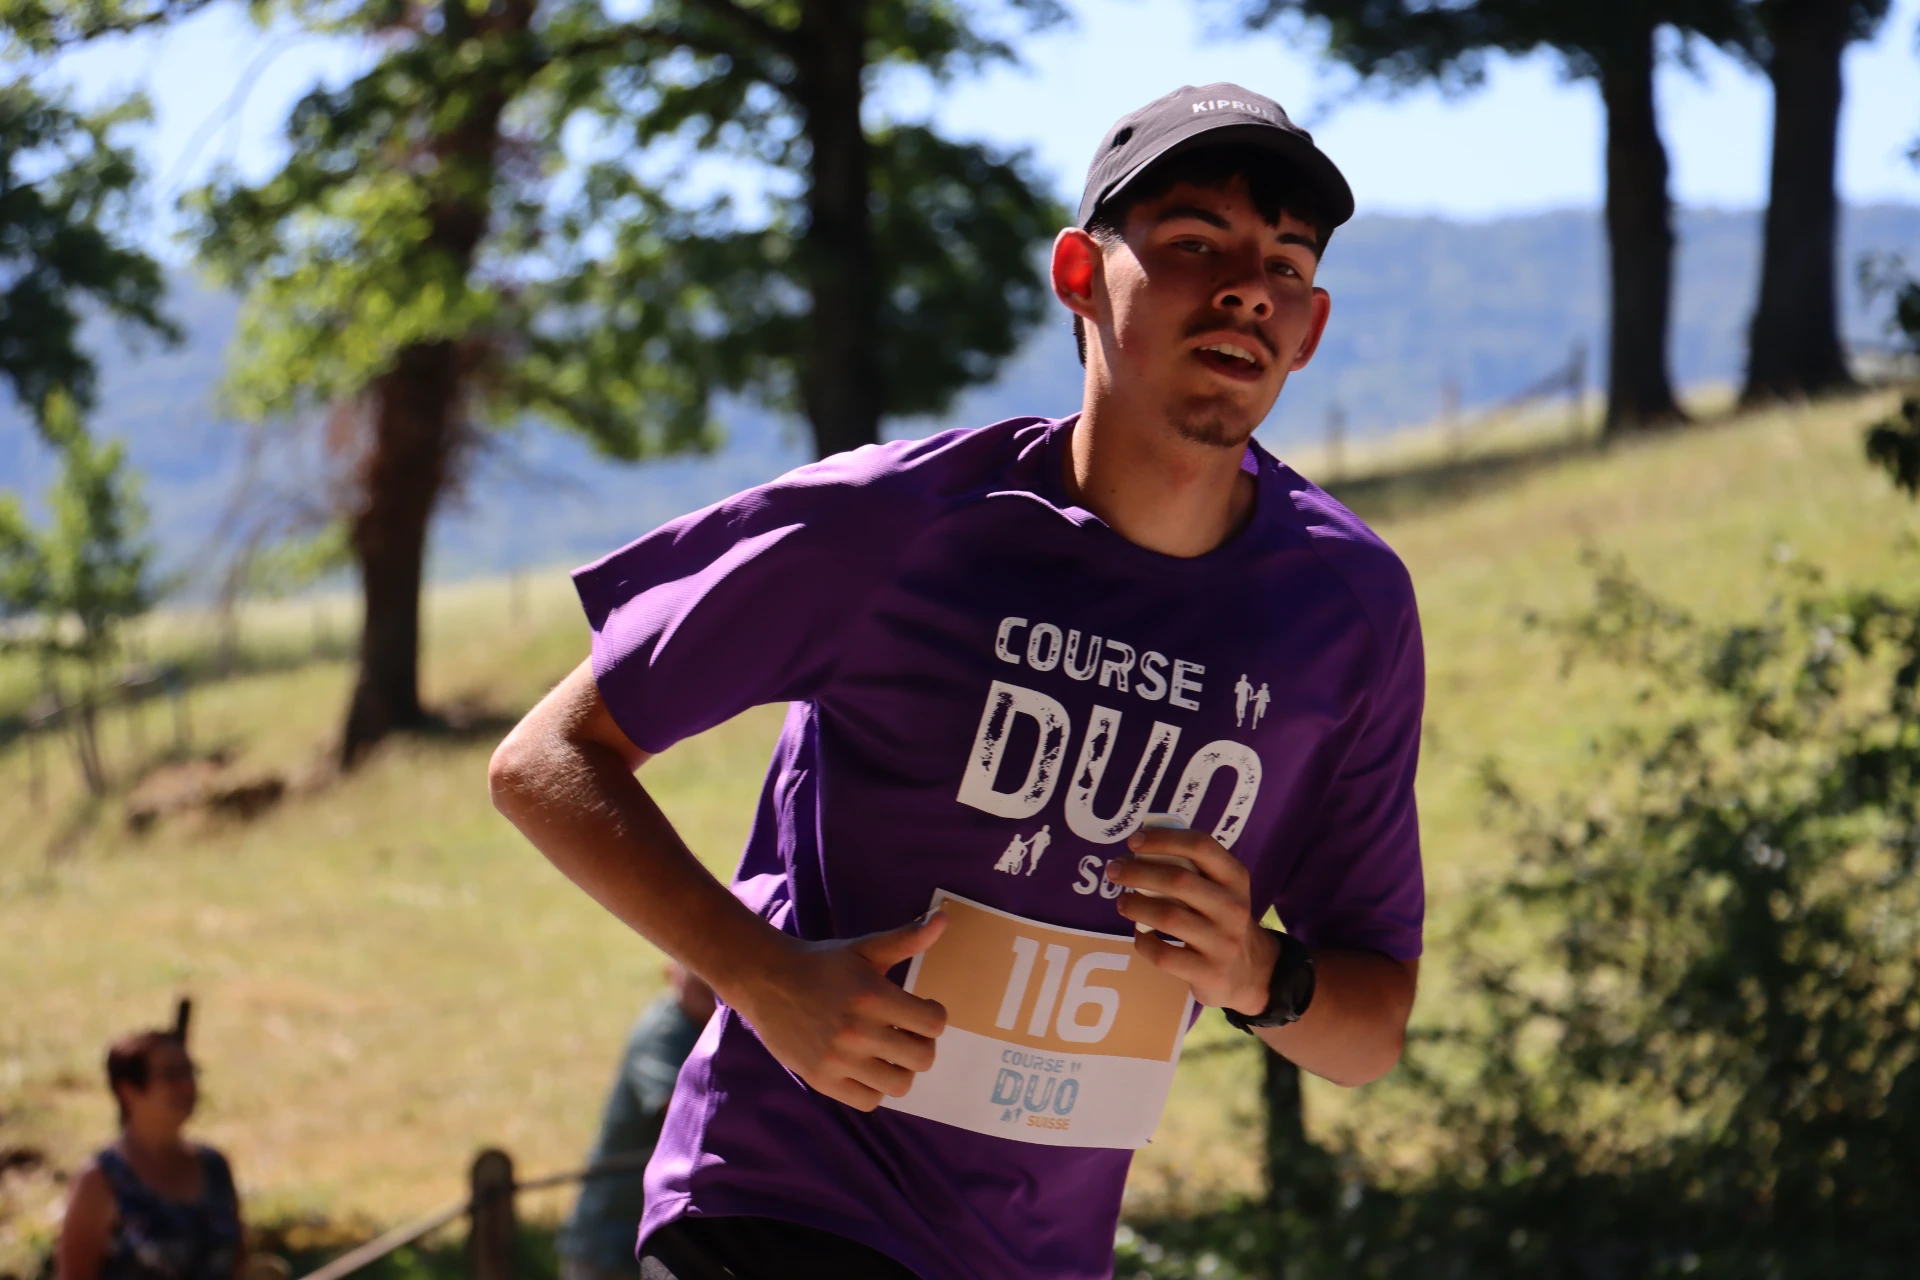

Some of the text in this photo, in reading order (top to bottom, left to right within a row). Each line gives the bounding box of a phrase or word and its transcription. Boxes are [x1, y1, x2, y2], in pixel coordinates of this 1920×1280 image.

[995, 616, 1206, 712] COURSE
[956, 679, 1263, 850] DUO
[995, 936, 1131, 1044] 116
[990, 1067, 1079, 1116] DUO
[1001, 1049, 1065, 1073] COURSE
[1026, 1115, 1071, 1131] SUISSE
